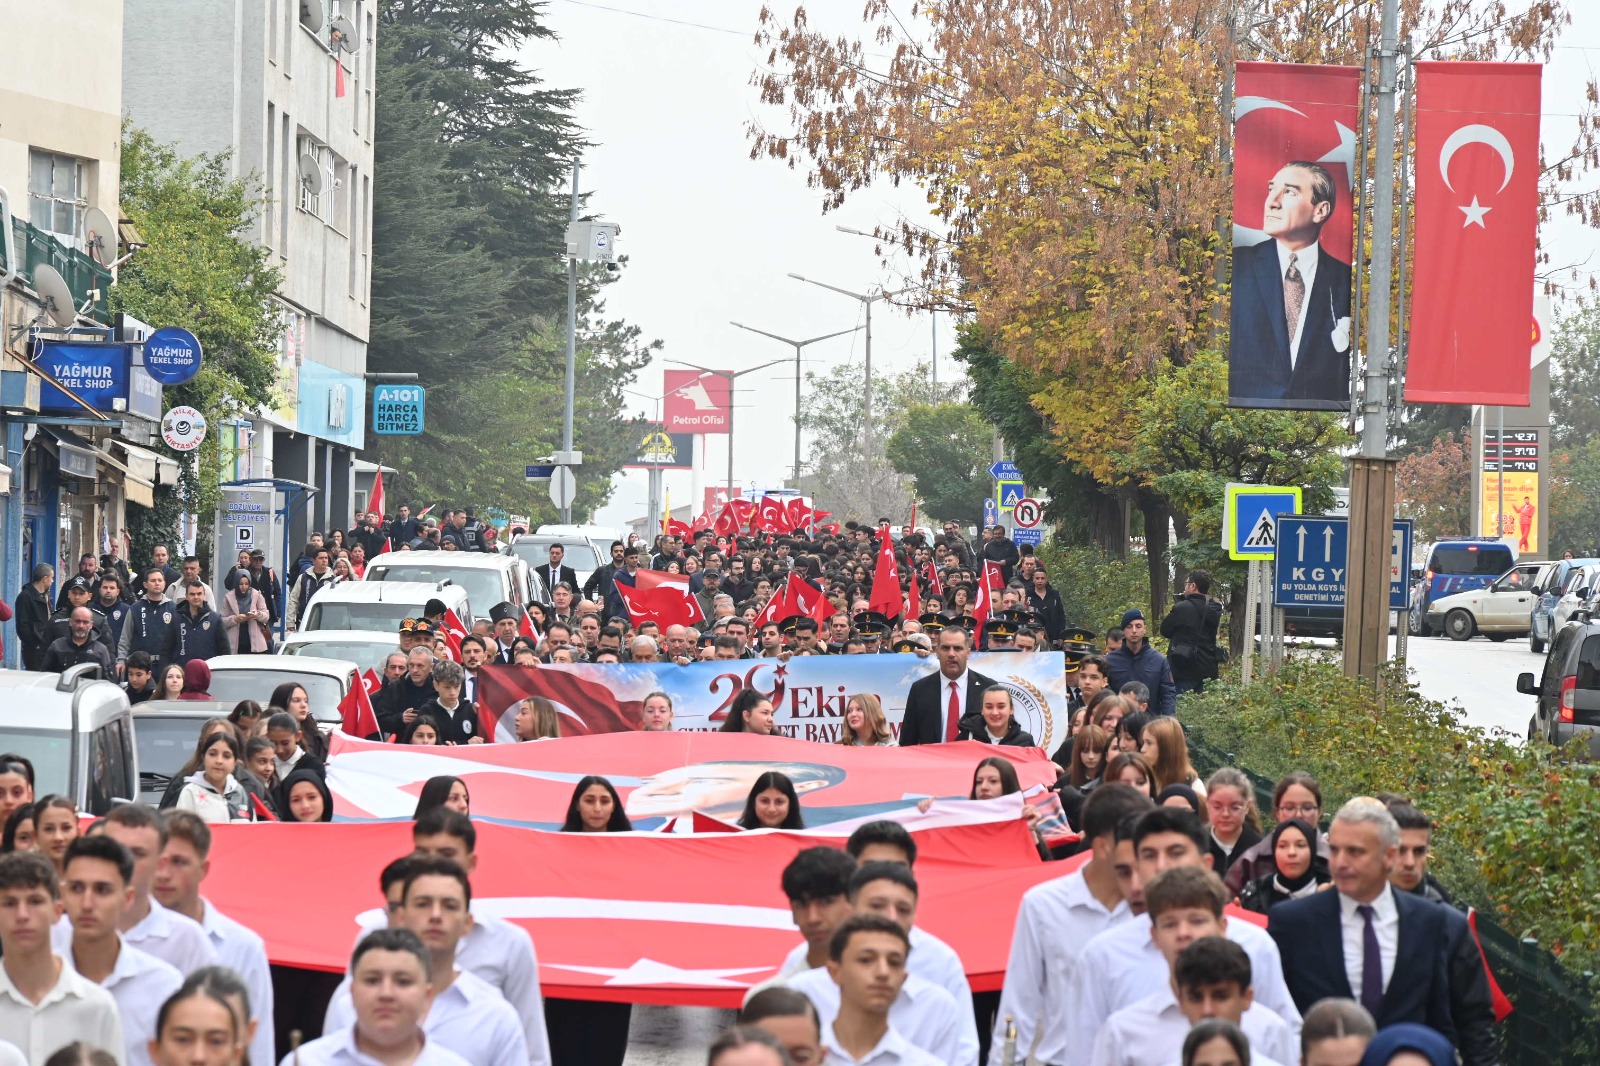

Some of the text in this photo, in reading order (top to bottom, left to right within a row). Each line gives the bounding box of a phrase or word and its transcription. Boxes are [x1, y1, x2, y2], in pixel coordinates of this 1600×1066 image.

[151, 346, 193, 358] YAĞMUR
[149, 356, 194, 365] TEKEL SHOP
[53, 362, 112, 379] YAĞMUR
[54, 378, 114, 389] EKEL SHOP
[378, 404, 418, 413] HARCA
[378, 413, 418, 422] HARCA
[672, 415, 724, 425] Petrol Ofisi
[239, 528, 251, 540] D
[1281, 583, 1292, 591] BU
[1294, 583, 1317, 591] YOLDA
[1318, 584, 1338, 592] KGYS
[1330, 594, 1345, 602] YAP
[788, 685, 881, 719] Eki
